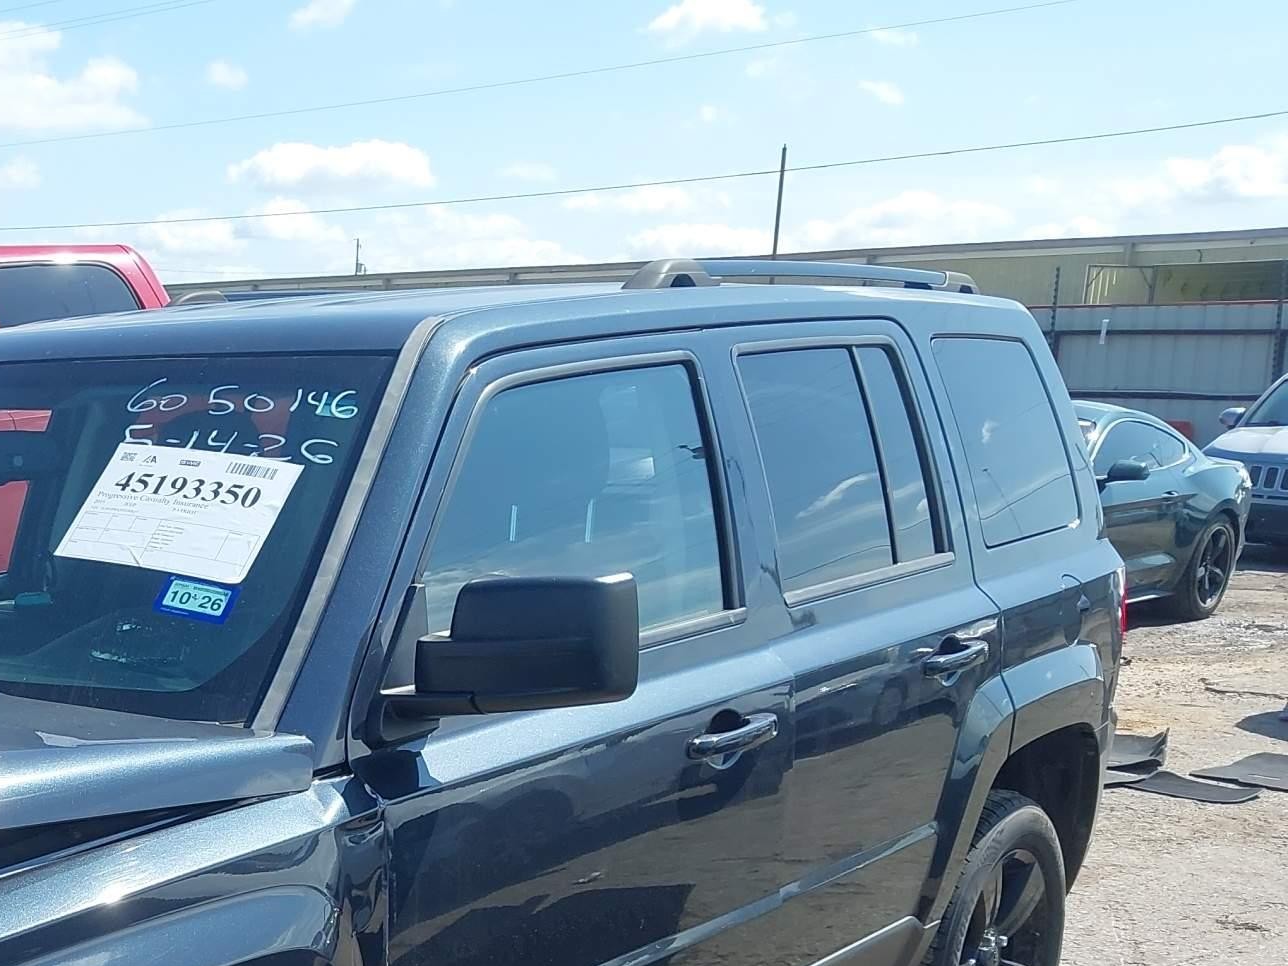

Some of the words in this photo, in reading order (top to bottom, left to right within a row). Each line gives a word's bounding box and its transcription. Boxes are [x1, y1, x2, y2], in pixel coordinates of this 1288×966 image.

[114, 471, 262, 509] 45193350
[170, 590, 192, 605] 10
[198, 595, 224, 612] 26
